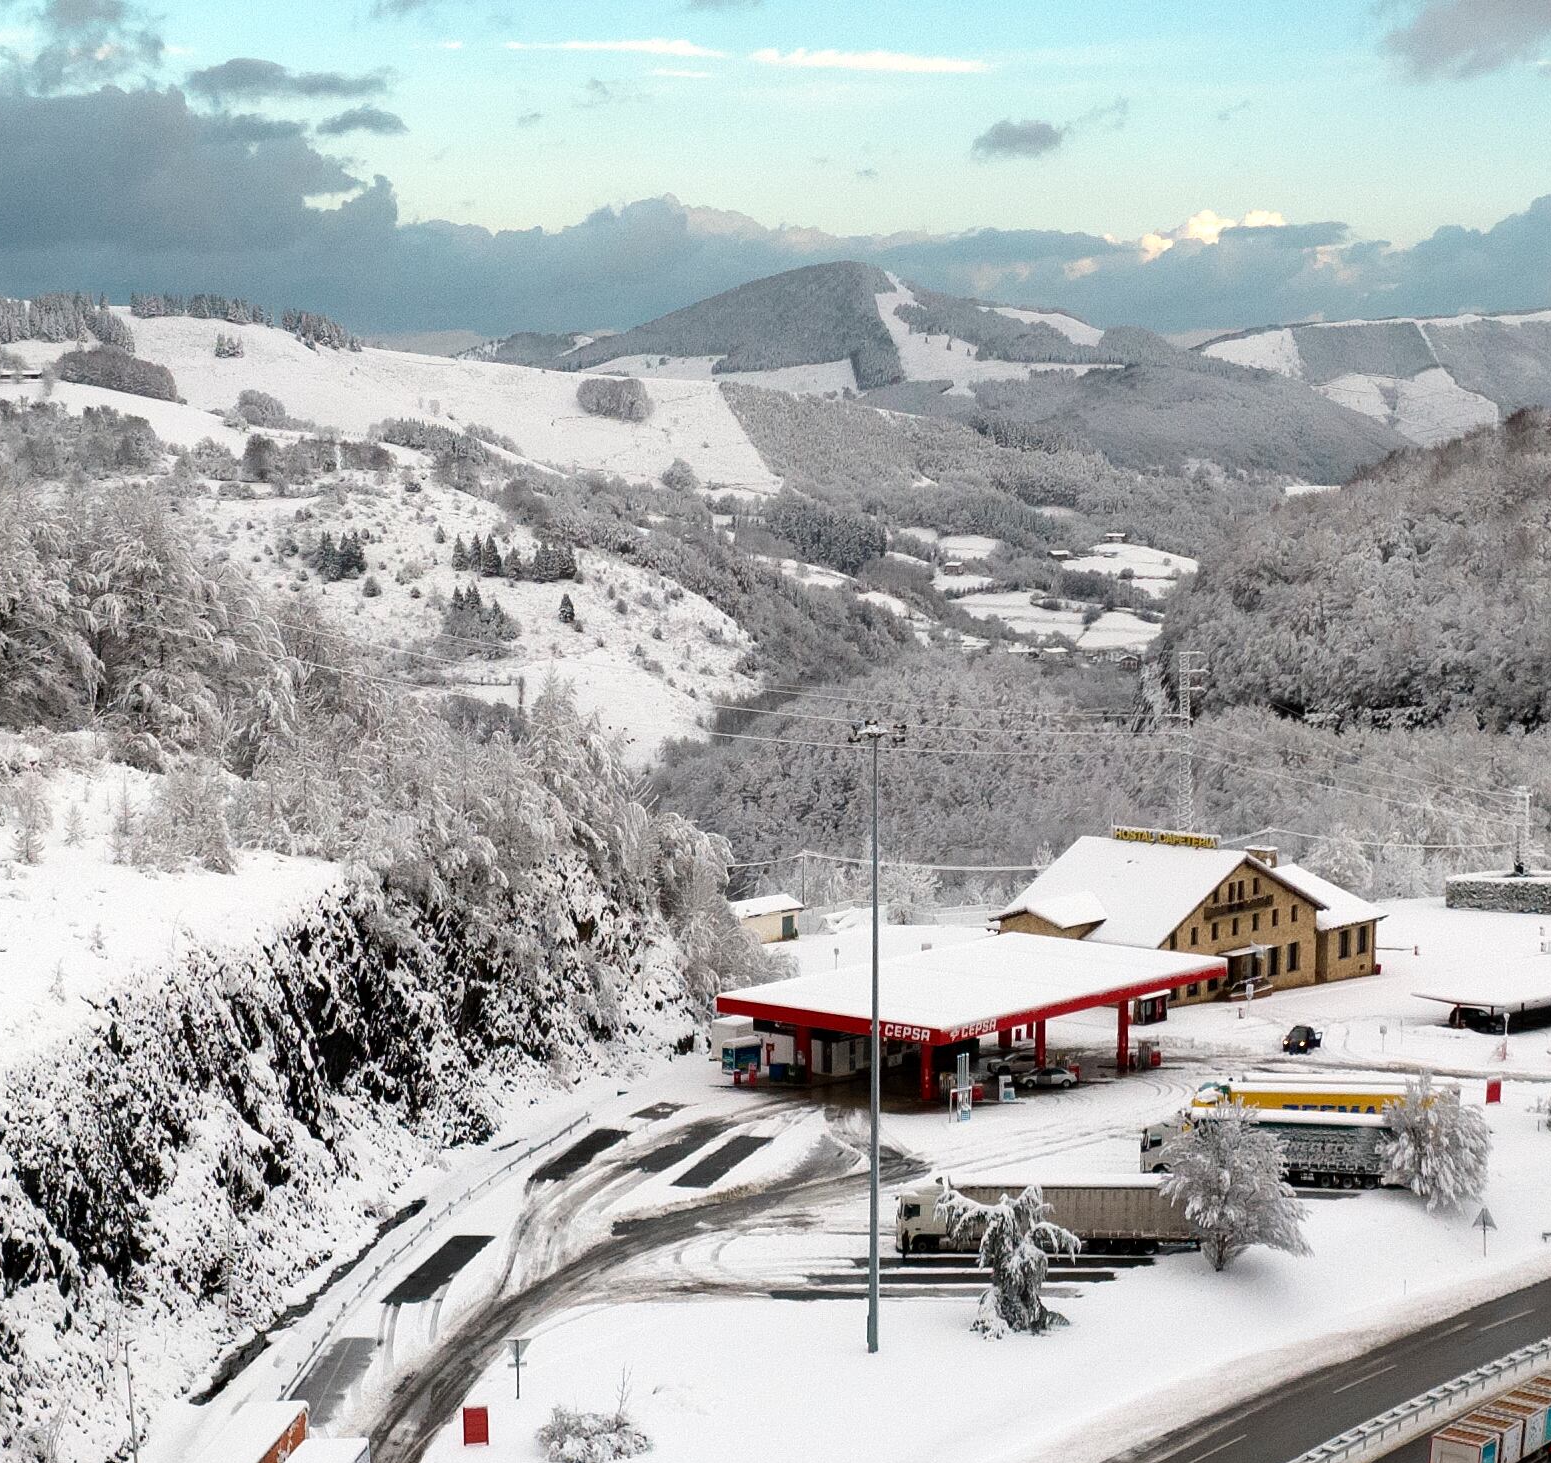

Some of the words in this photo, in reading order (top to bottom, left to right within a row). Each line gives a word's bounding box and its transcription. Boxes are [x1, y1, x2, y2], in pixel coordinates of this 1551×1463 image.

[1114, 828, 1154, 843] HOSTAL
[1158, 832, 1219, 849] CAFETERIA
[884, 1024, 930, 1041] CEPSA
[961, 1020, 996, 1038] CEPSA
